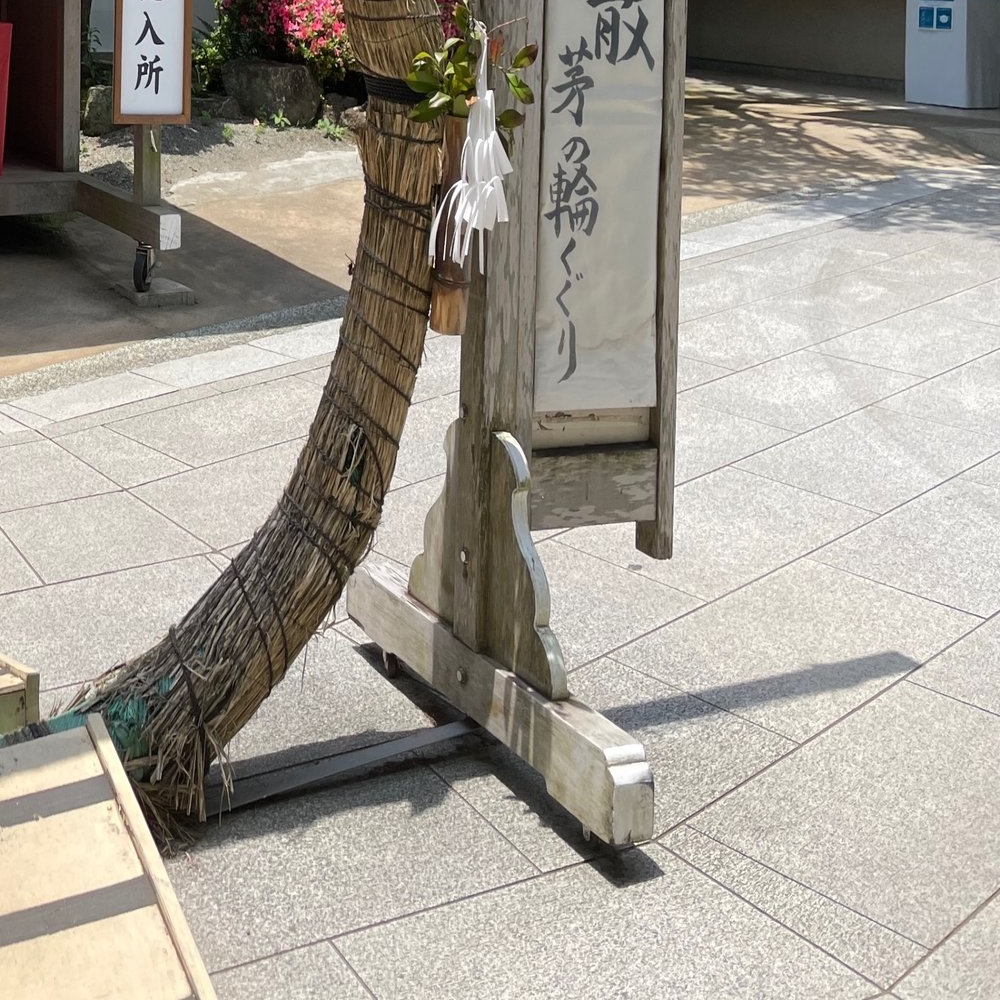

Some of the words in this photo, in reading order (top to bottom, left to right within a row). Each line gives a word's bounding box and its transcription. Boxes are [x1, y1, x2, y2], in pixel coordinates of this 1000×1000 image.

[543, 43, 600, 386] 茅の輪くぐり
